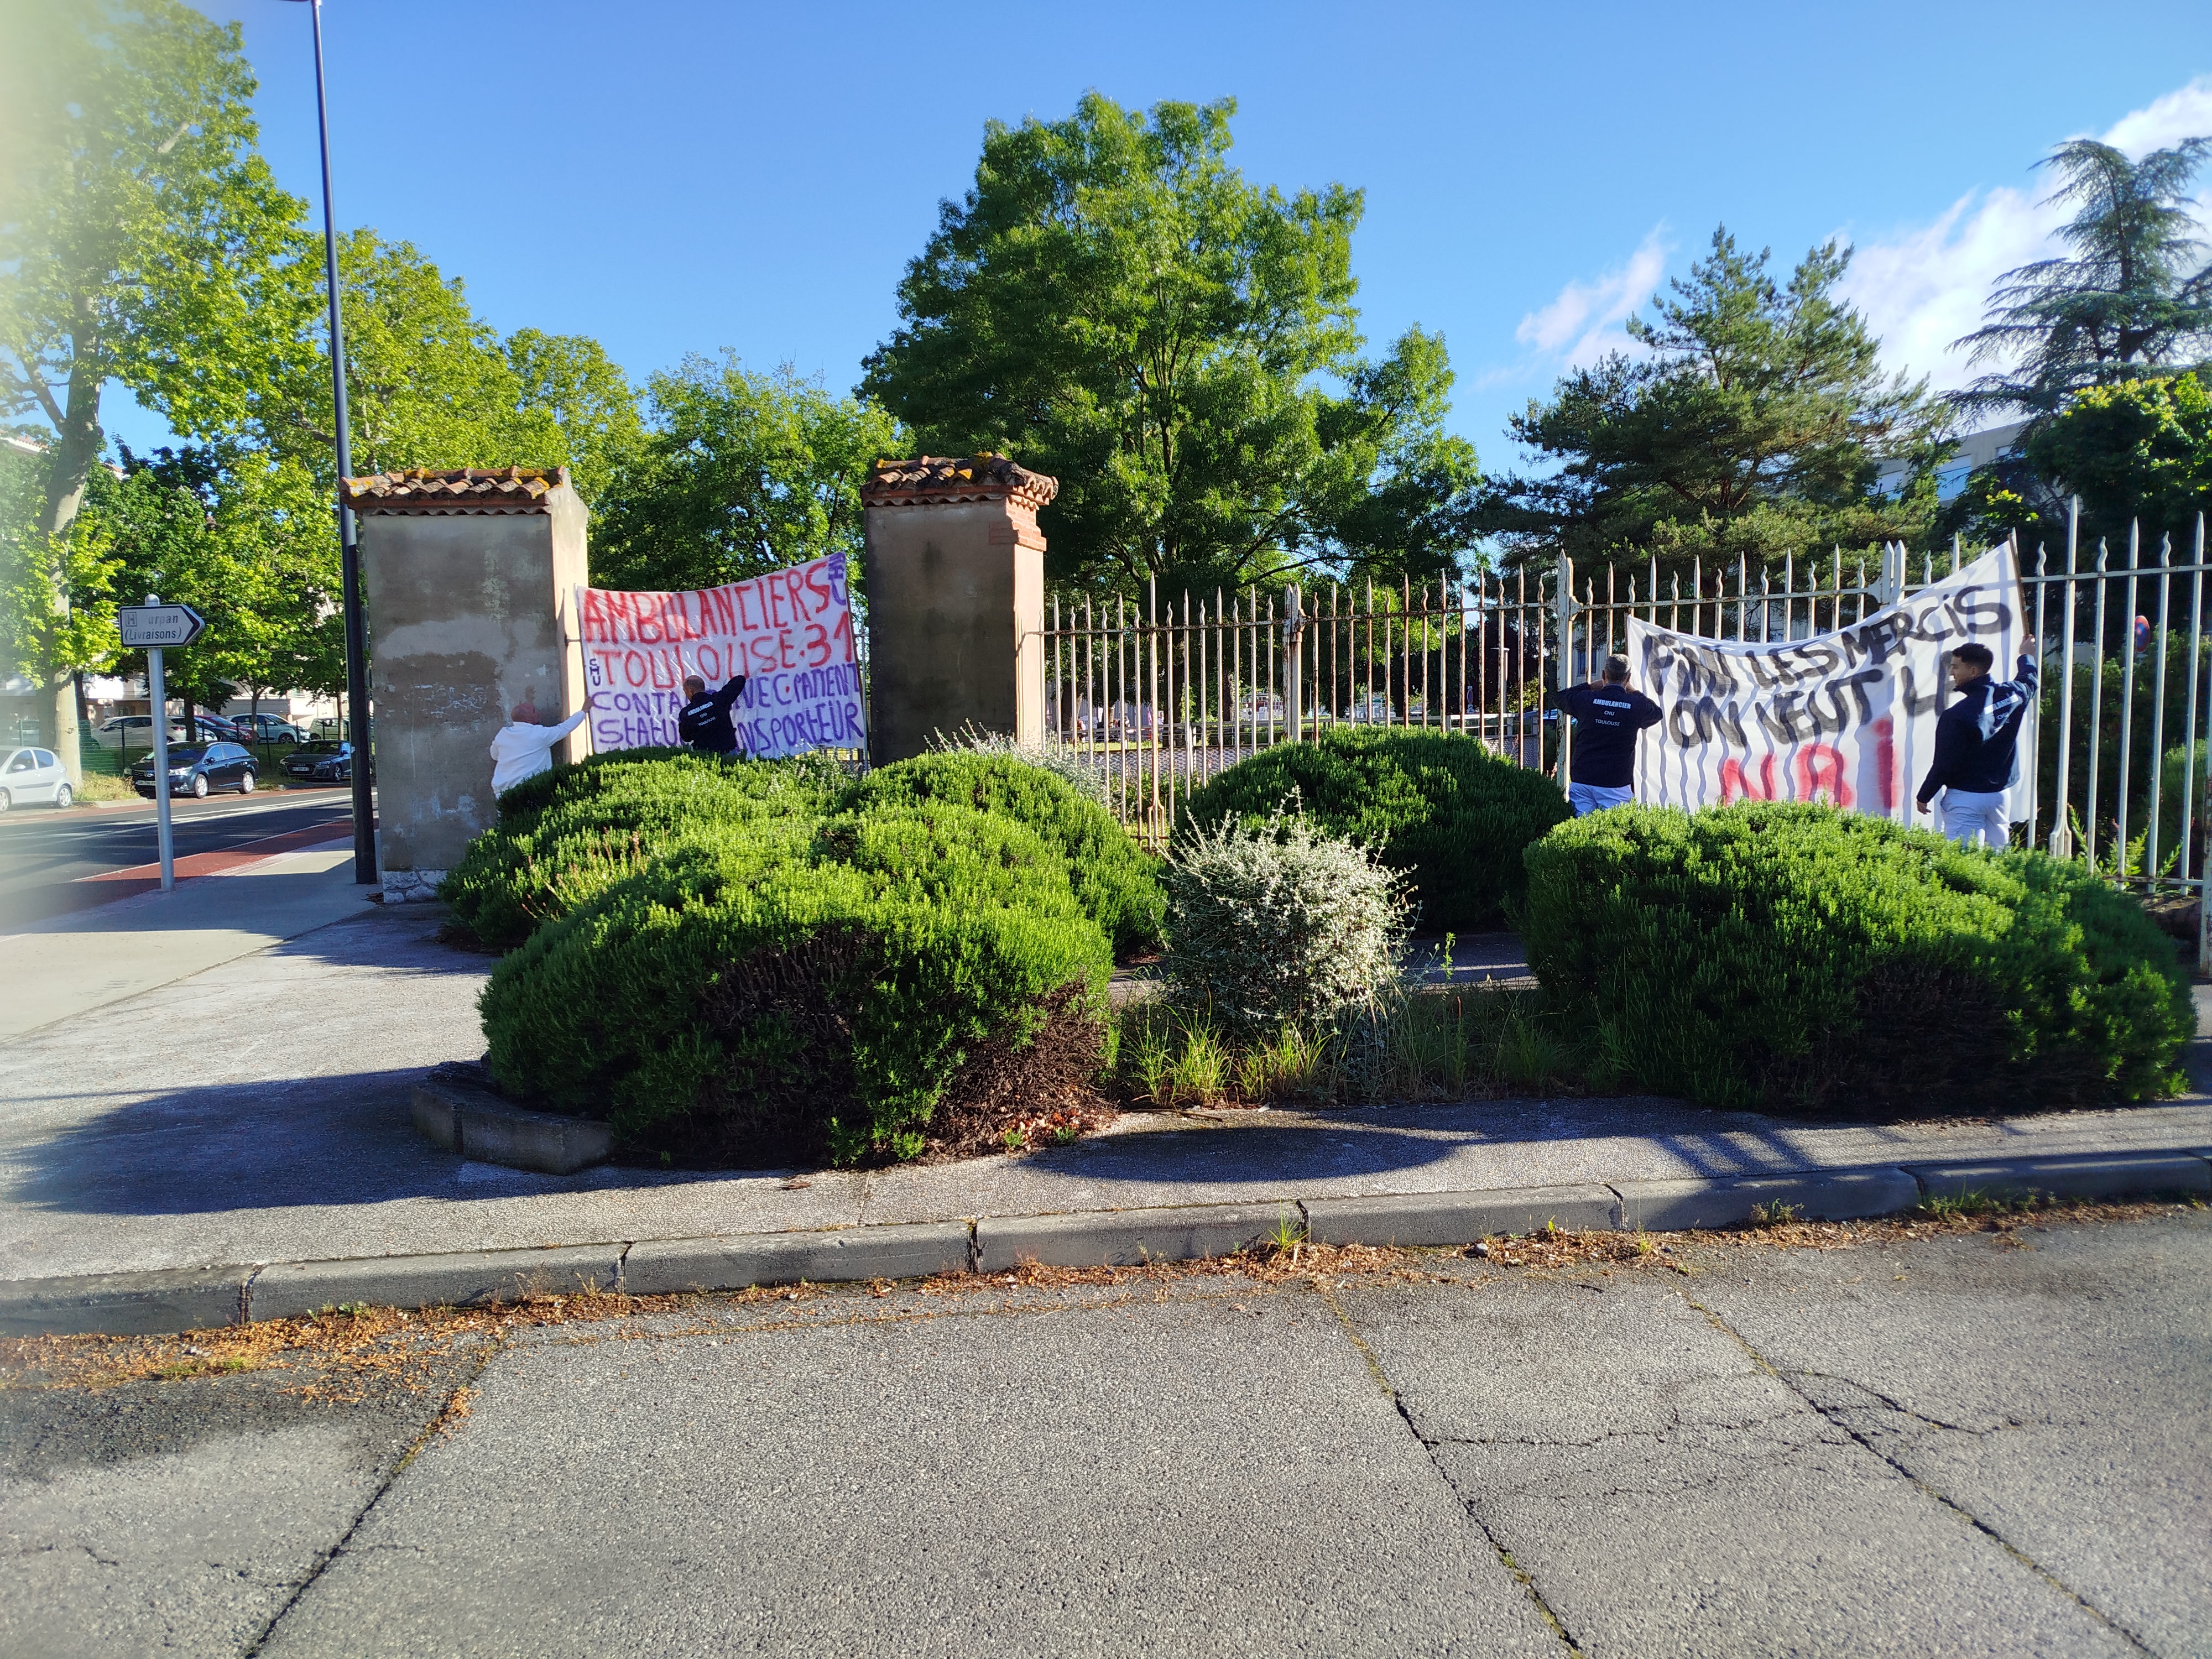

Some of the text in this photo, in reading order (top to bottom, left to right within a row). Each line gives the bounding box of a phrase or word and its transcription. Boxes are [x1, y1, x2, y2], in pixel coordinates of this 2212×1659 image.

[584, 561, 829, 645] AMBULANCIERS
[147, 615, 178, 627] urpan
[589, 658, 601, 686] CHU
[1745, 639, 1839, 689] LES
[591, 689, 717, 716] CONTA
[1593, 698, 1631, 709] AMBULANCIER
[1595, 718, 1621, 727] TOULOUSE
[1669, 695, 1749, 748] ON
